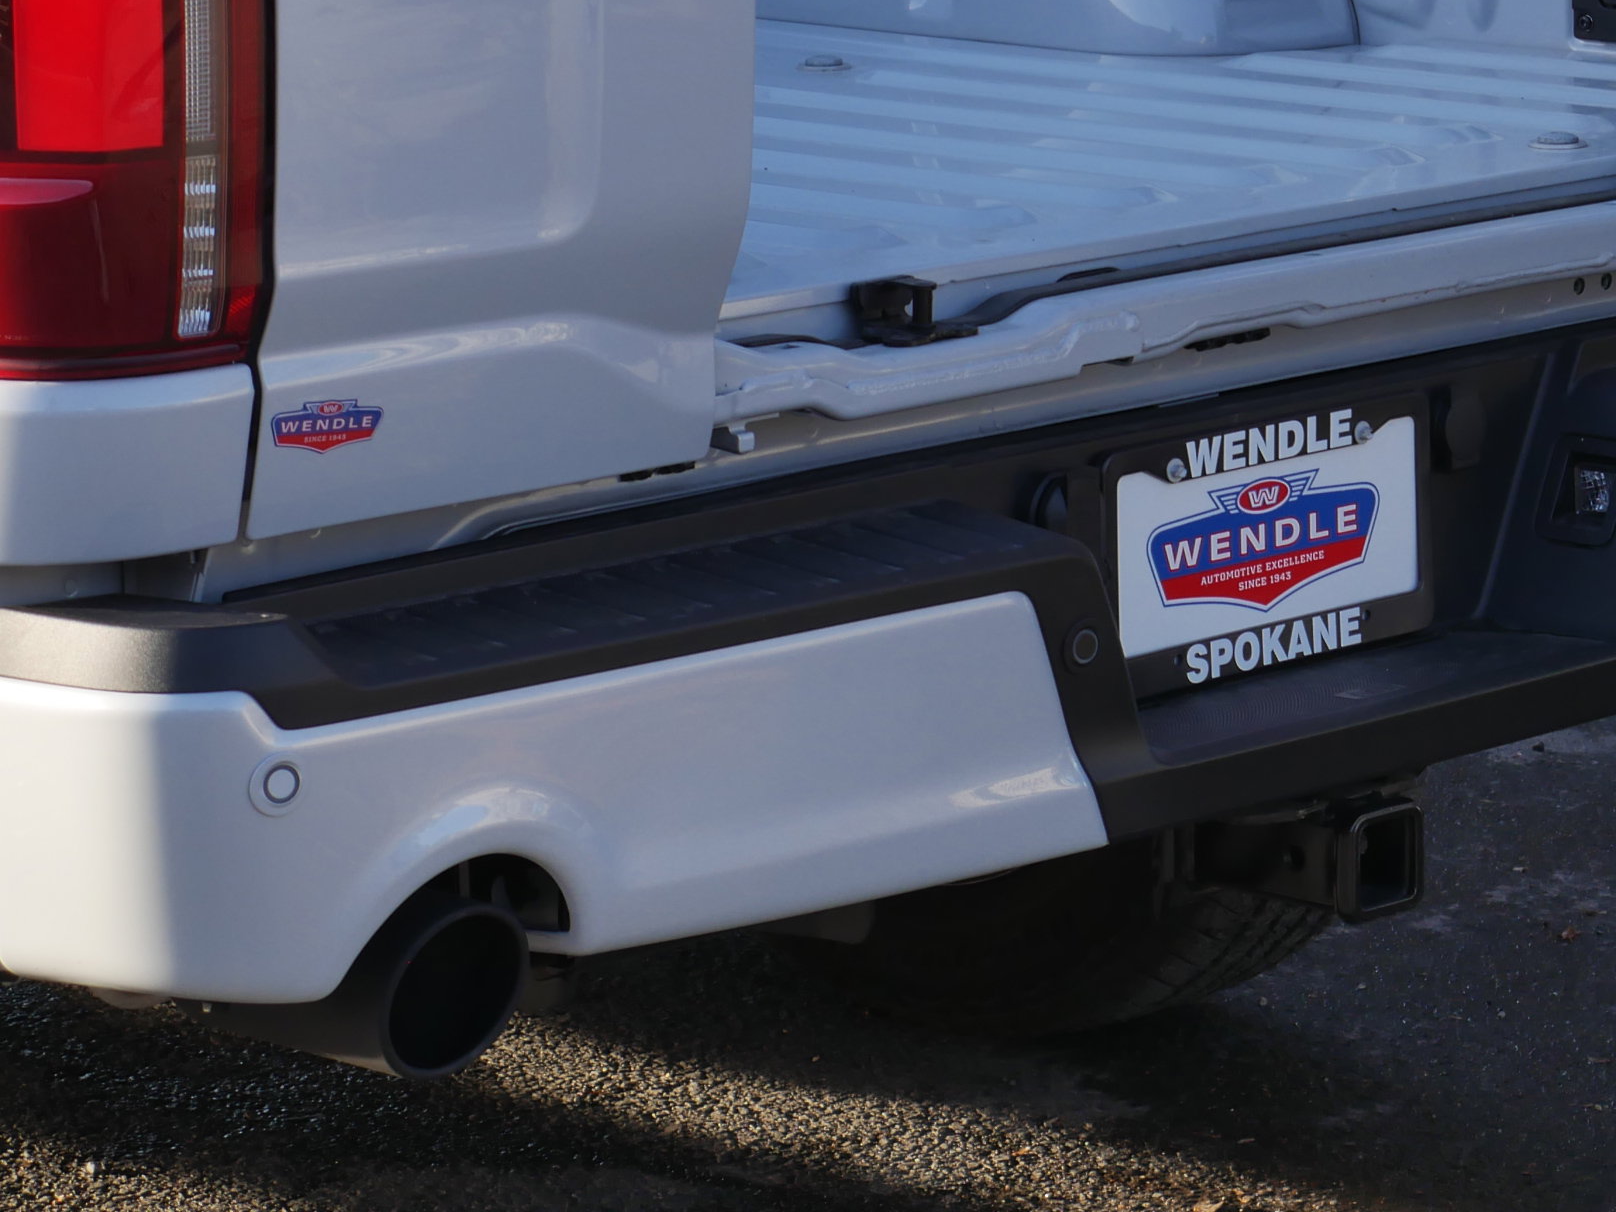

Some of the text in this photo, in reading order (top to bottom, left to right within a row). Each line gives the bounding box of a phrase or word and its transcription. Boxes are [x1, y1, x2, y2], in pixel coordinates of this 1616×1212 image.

[281, 416, 373, 433] WENDLE
[304, 435, 327, 443] SINCE
[1186, 408, 1352, 478] WENDLE
[1248, 486, 1279, 508] W
[1164, 504, 1357, 571] WENDLE
[1201, 550, 1325, 586] AUTOMOTIVE EXCELLENCE
[1238, 571, 1292, 591] SINCE 1943
[1186, 607, 1362, 684] SPOKANE
